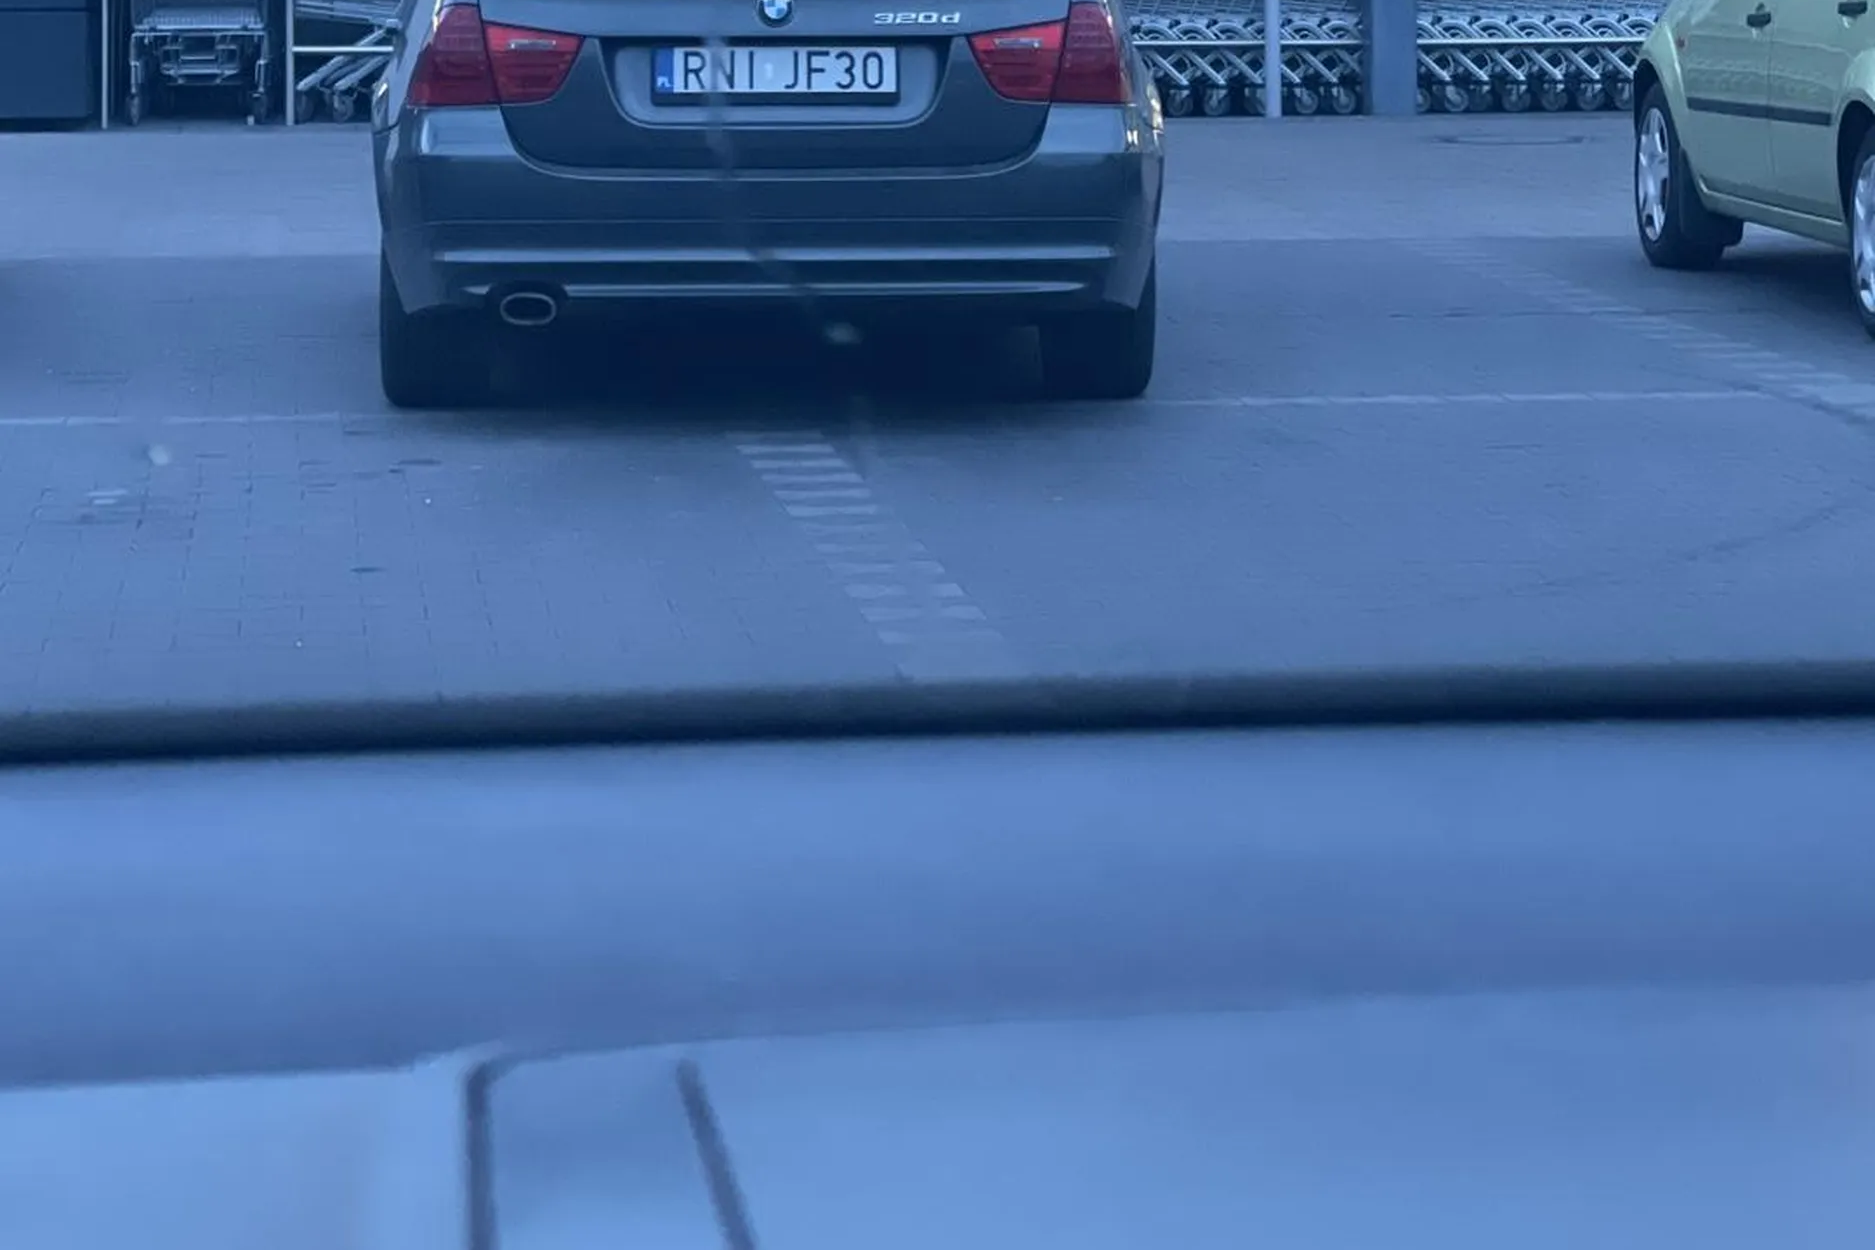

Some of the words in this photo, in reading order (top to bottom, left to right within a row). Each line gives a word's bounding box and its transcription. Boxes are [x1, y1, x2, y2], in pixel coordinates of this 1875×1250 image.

[873, 12, 961, 24] 320d
[682, 50, 755, 91] RNI
[784, 50, 884, 91] JF30
